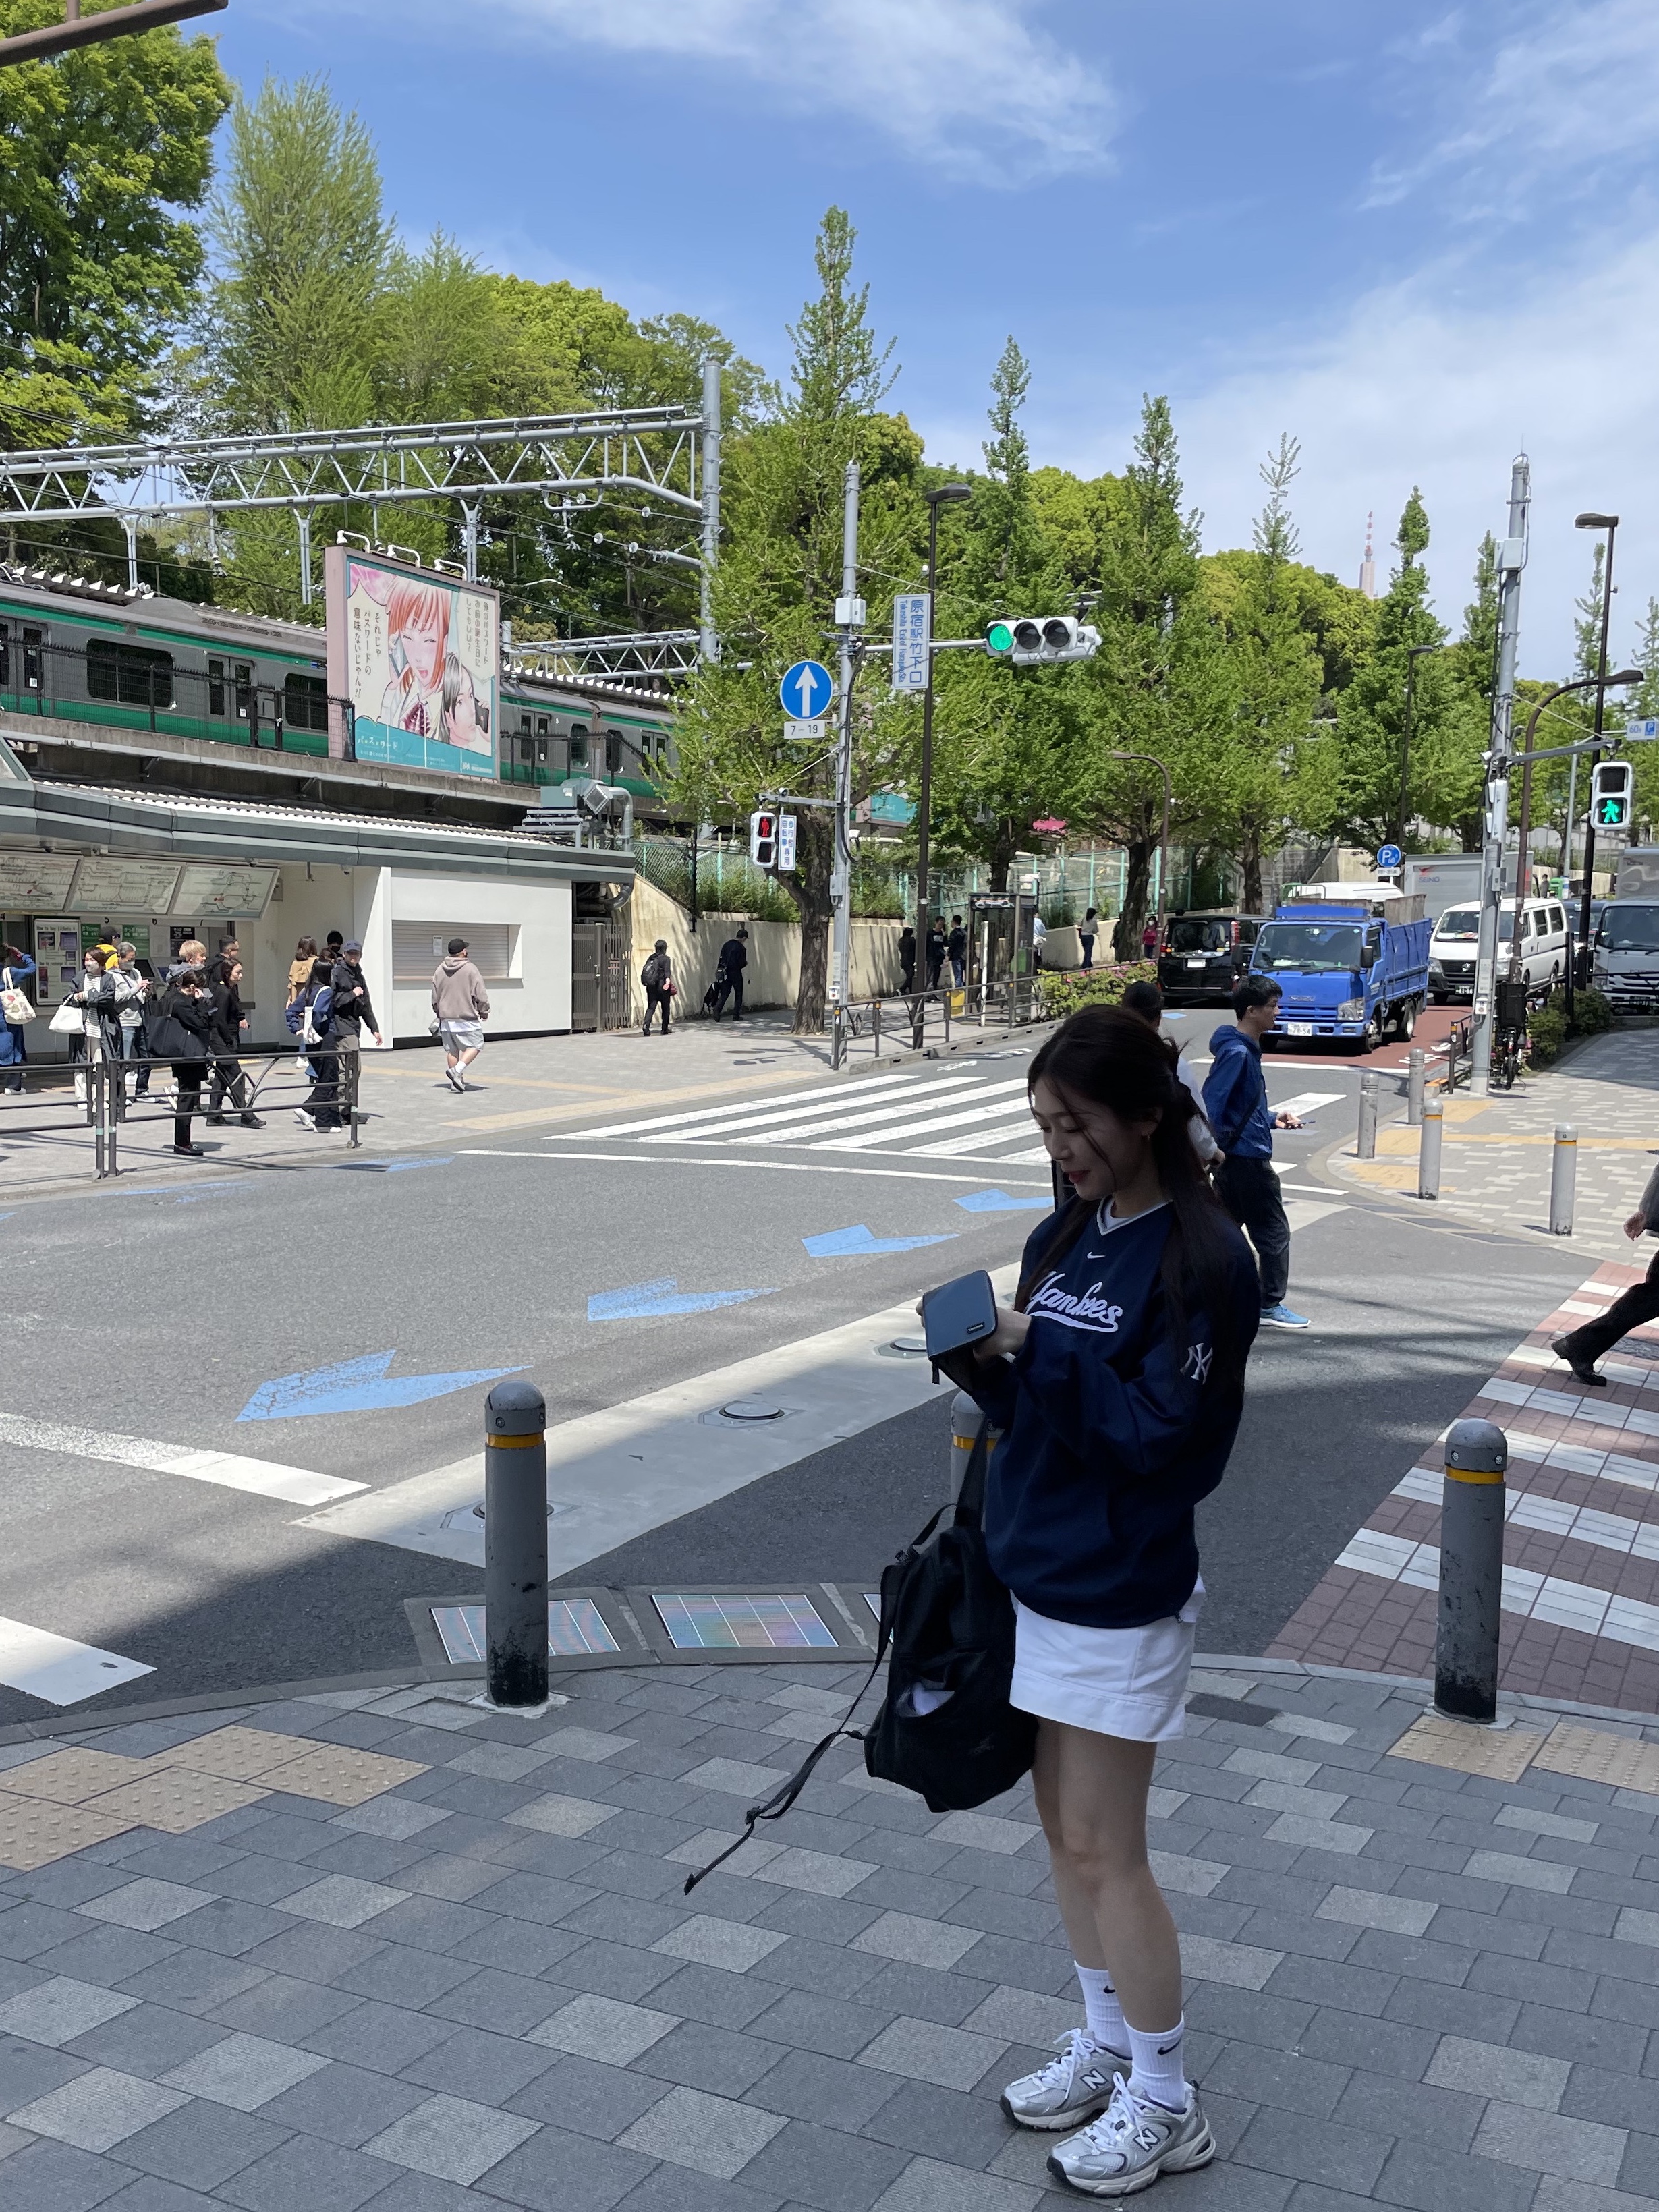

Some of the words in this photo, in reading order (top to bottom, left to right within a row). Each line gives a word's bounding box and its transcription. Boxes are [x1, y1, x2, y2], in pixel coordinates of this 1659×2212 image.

[899, 600, 908, 627] Takeshita
[364, 610, 372, 675] パスワードの
[909, 599, 924, 683] 原宿駅竹下口
[1382, 849, 1392, 864] P
[1418, 876, 1440, 884] SEINO
[1023, 1271, 1123, 1331] Yankees
[1179, 1342, 1214, 1385] NY
[1079, 2068, 1108, 2092] N
[1133, 2127, 1161, 2153] N
